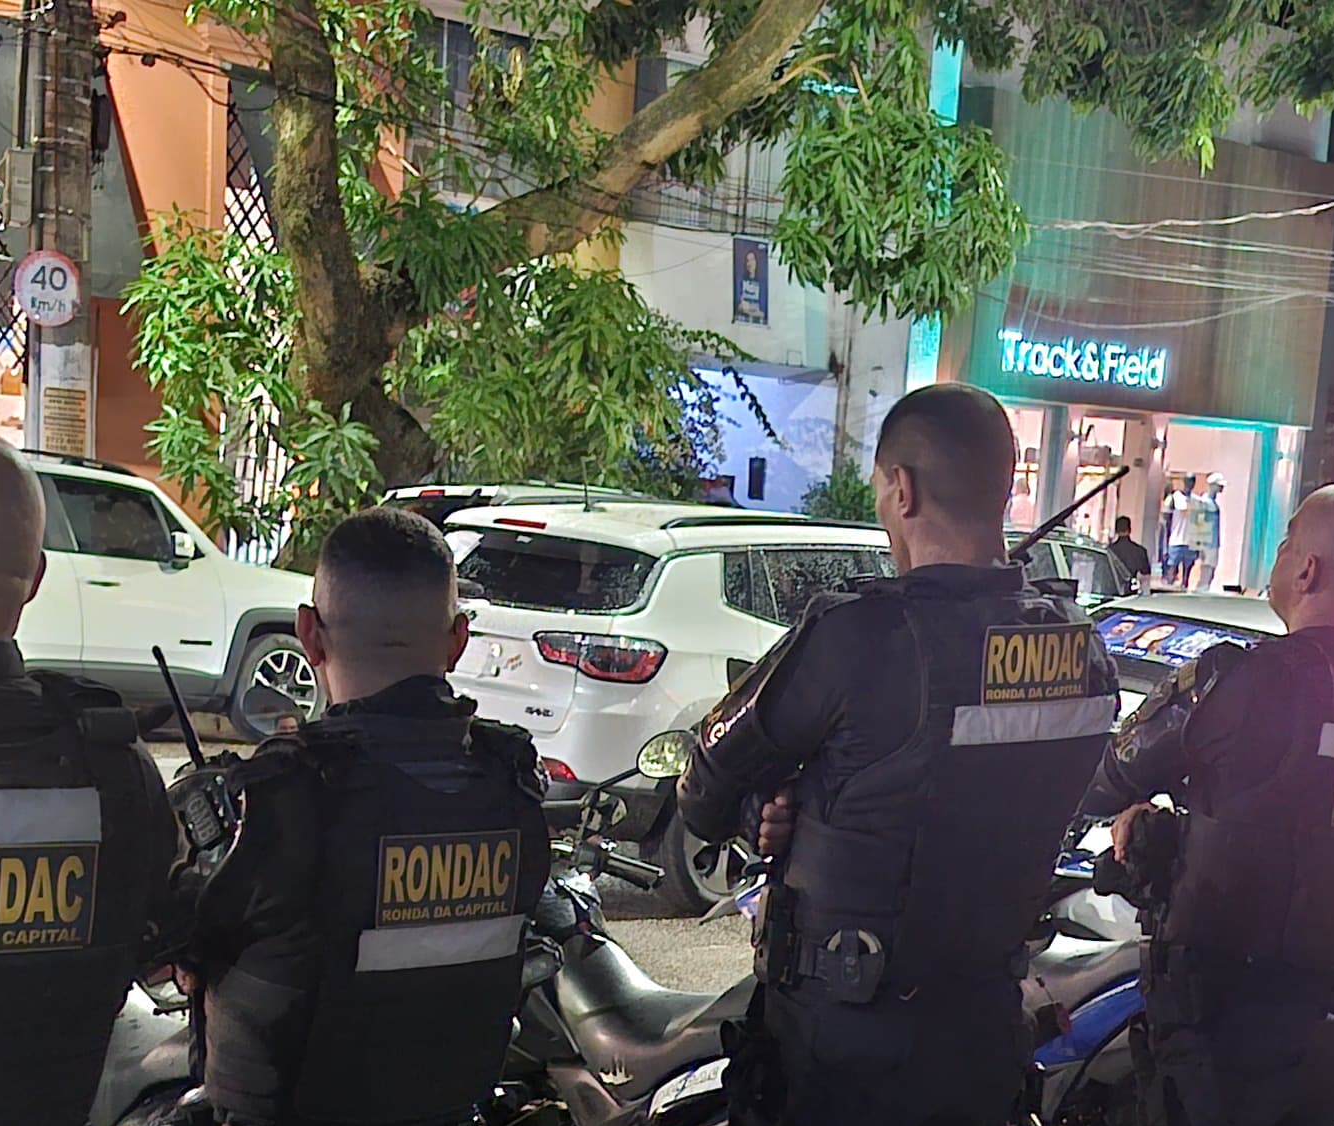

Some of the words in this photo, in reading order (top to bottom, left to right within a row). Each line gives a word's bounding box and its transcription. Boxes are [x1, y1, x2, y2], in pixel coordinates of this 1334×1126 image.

[30, 265, 67, 291] 40
[998, 328, 1166, 388] Track&Field
[987, 631, 1085, 684] RONDAC
[383, 840, 512, 904] RONDAC
[382, 906, 430, 921] RONDA
[433, 905, 452, 918] DA
[455, 901, 508, 917] CAPITAL
[2, 927, 82, 945] CAPITAL
